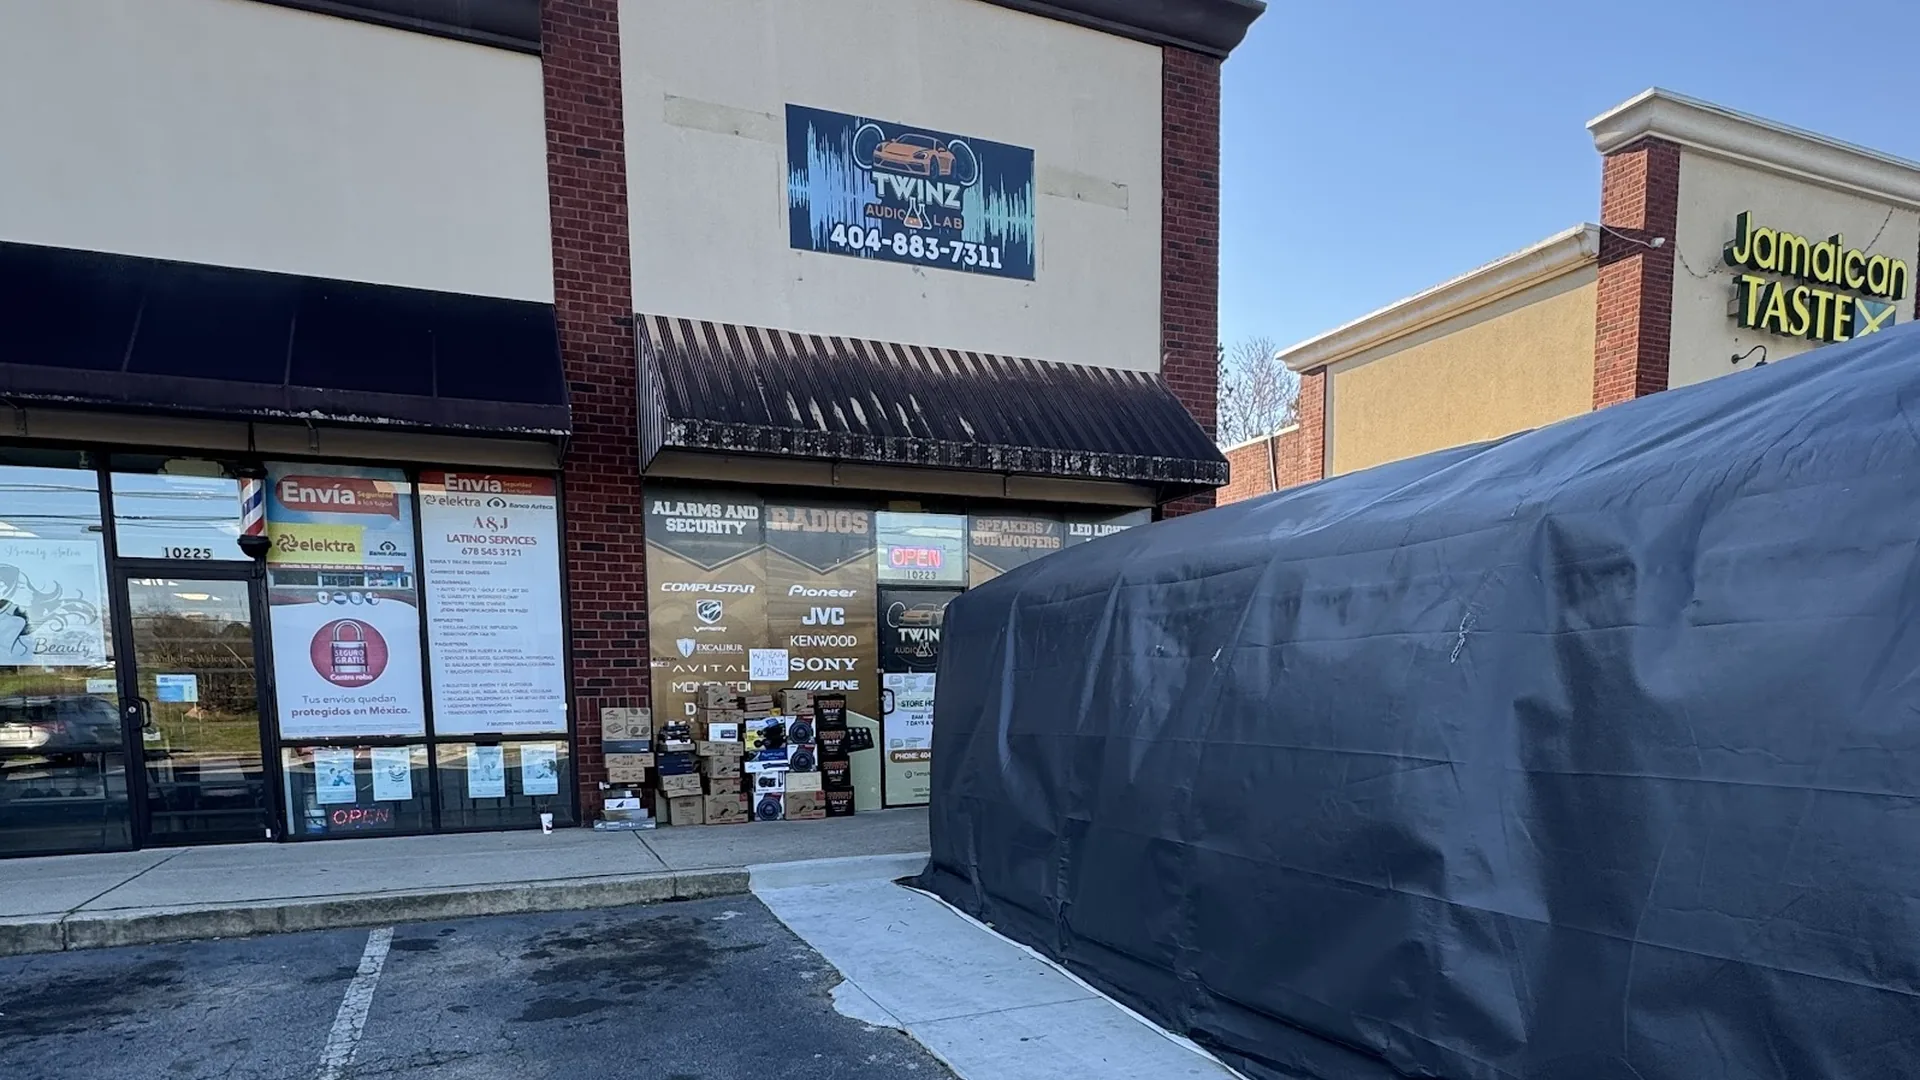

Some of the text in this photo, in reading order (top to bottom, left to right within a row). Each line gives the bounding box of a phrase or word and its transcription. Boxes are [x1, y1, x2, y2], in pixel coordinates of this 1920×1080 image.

[872, 174, 961, 209] TWINZ
[866, 204, 964, 229] AUDIO LAB
[830, 223, 1003, 269] 404-883-7311
[1730, 210, 1909, 301] Jamaican
[1738, 274, 1853, 342] TASTE
[444, 473, 503, 493] Envía
[281, 481, 356, 505] Envía
[439, 495, 481, 507] elektra
[652, 501, 759, 520] ALARMS AND
[666, 518, 747, 535] SECURITY
[770, 507, 868, 534] RADIOS
[976, 519, 1046, 534] SPEAKERS
[1069, 523, 1092, 536] LED
[300, 538, 356, 553] elektra
[447, 534, 537, 546] LATINO SERVICES
[972, 534, 1061, 549] SUBWOOFERS
[163, 547, 212, 560] 10225
[461, 547, 522, 557] 678 545 3121
[891, 548, 941, 568] OPEN
[907, 570, 937, 580] 10223
[661, 582, 755, 594] COMPUSTAR
[788, 584, 857, 598] Pioneer
[802, 607, 845, 626] JVC
[790, 635, 858, 647] KENWOOD
[898, 628, 941, 642] TWIN
[33, 637, 90, 657] Beauty
[334, 648, 365, 657] SEGURO
[697, 643, 744, 652] EXCALIBUR
[335, 656, 365, 664] GRATIS
[789, 657, 859, 672] SONY
[672, 664, 750, 673] AVITAL
[330, 673, 355, 681] Contra
[793, 680, 859, 690] ALPINE
[302, 694, 397, 706] Tus envíos quedan
[901, 700, 924, 708] STORE
[291, 707, 352, 719] protegidos
[370, 706, 411, 715] México.
[332, 808, 389, 824] OPEN
